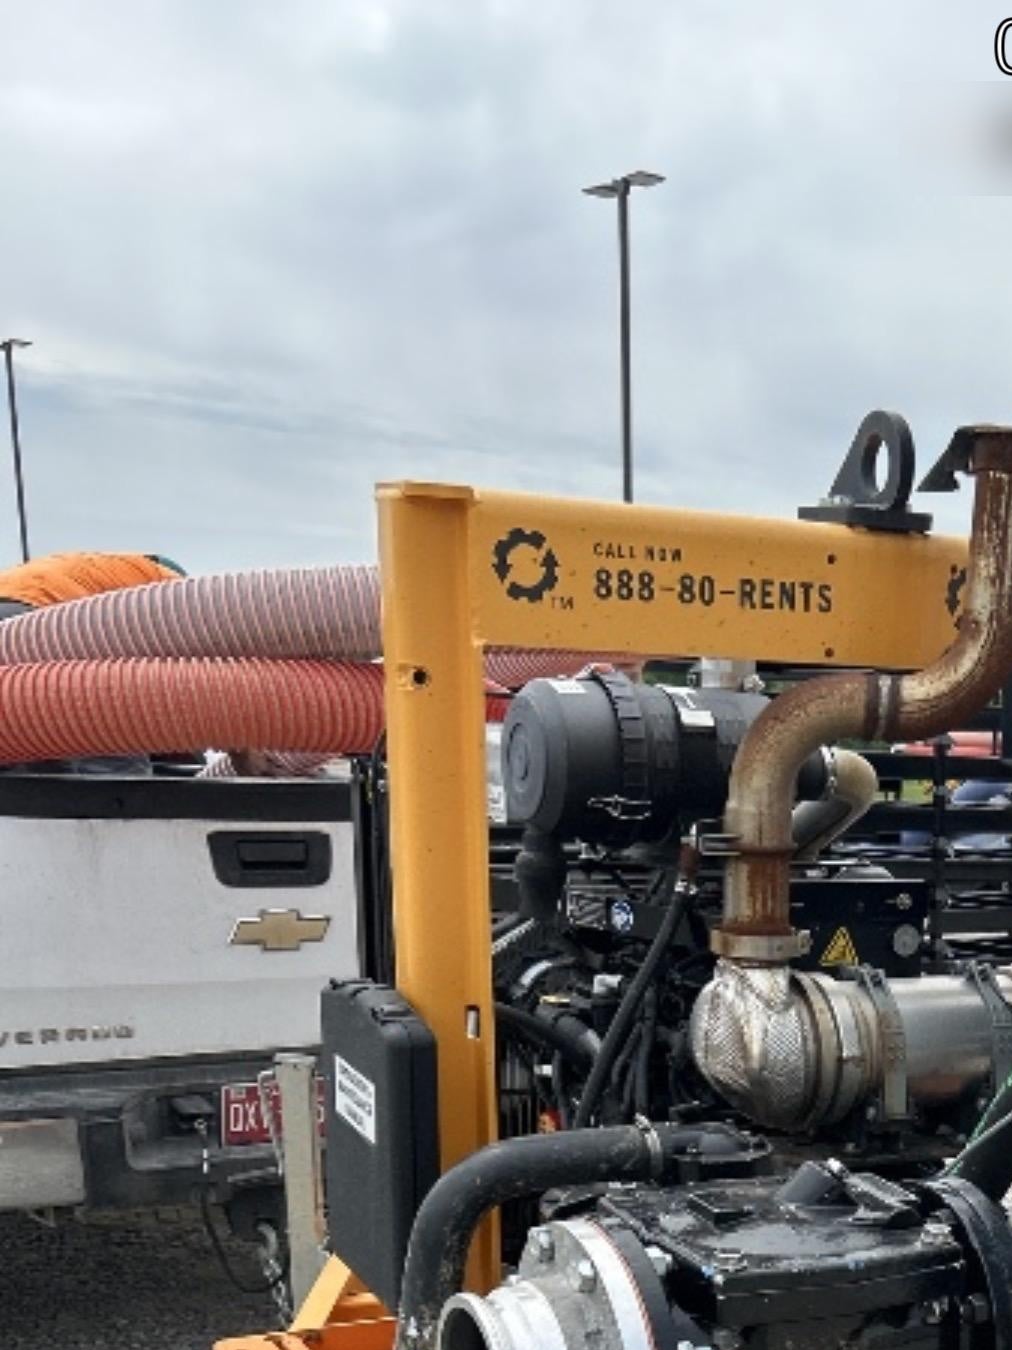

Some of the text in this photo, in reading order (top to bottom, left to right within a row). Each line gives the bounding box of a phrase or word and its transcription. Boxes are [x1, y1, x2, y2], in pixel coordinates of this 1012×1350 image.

[592, 542, 682, 562] CALL NOW
[593, 567, 833, 613] 888-80-RENTS
